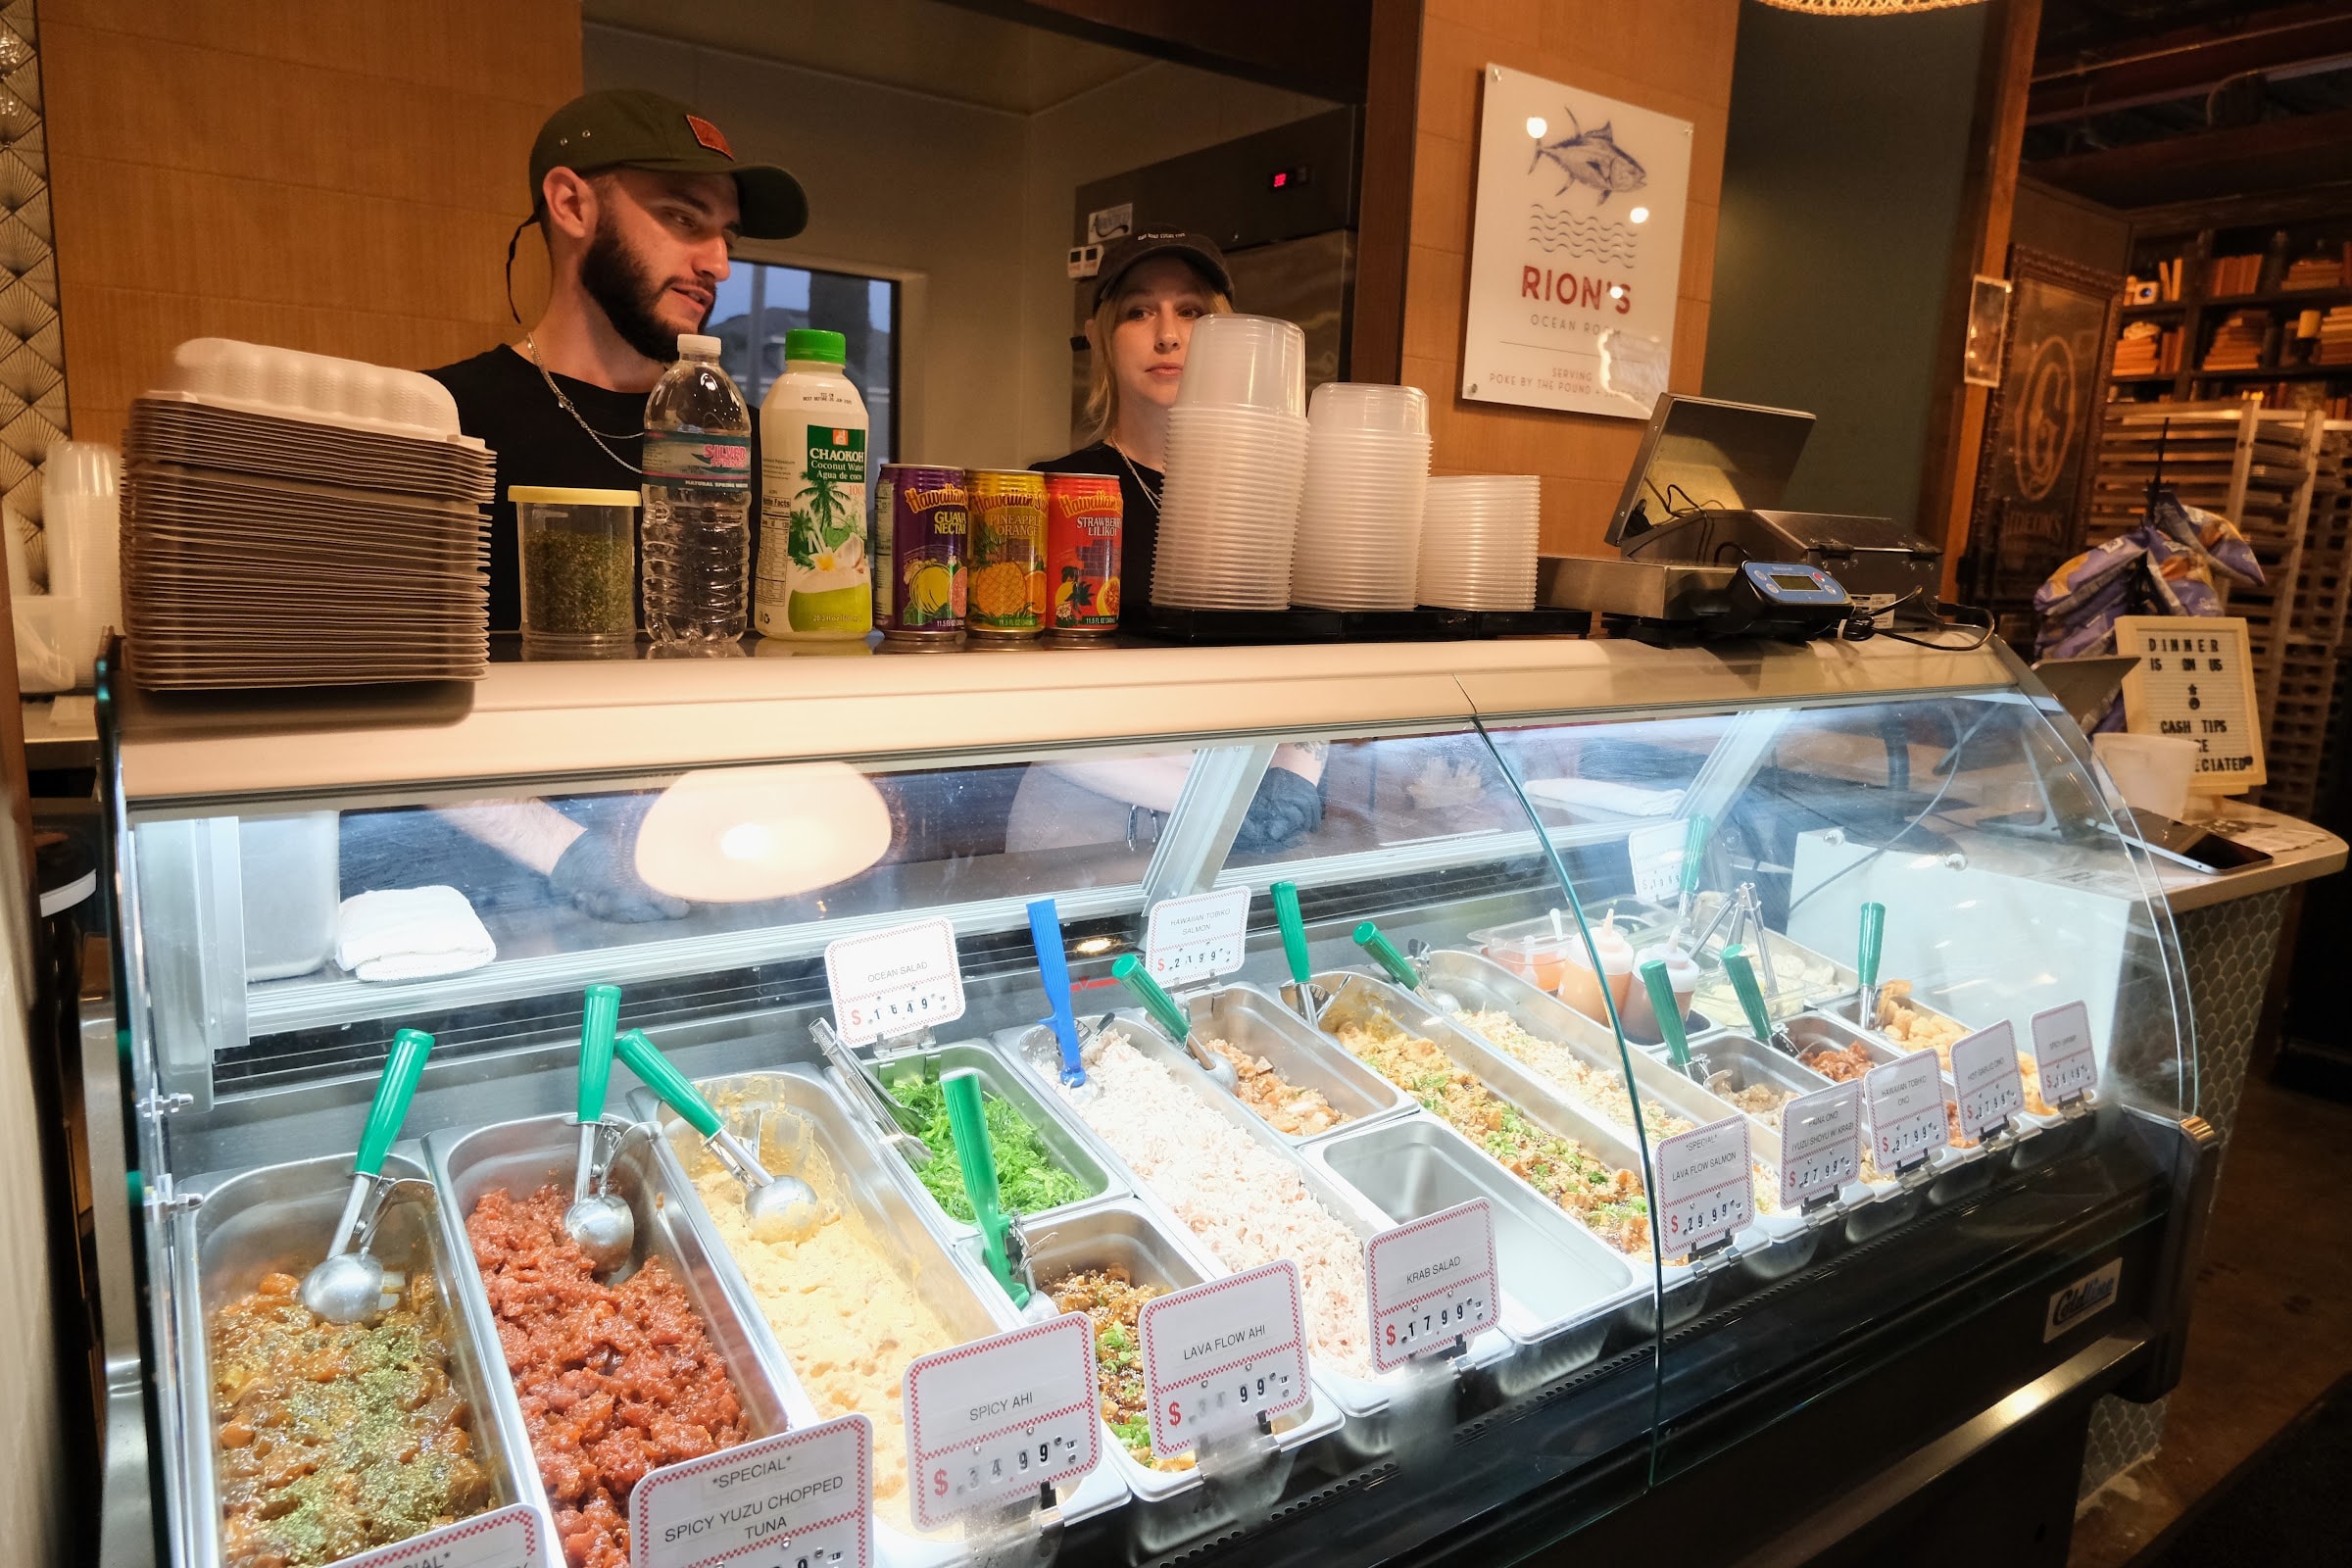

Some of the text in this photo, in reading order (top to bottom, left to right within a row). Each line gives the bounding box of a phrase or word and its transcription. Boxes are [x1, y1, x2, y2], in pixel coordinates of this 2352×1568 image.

[1521, 265, 1632, 315] RION'S
[1530, 314, 1576, 331] OCEAN
[1551, 368, 1592, 383] SERVING
[1489, 372, 1516, 386] POKE
[1520, 376, 1533, 388] BY
[1537, 378, 1554, 391] THE
[1558, 381, 1592, 395] POUND
[703, 443, 747, 461] SILVER
[808, 447, 864, 463] CHAOKOH
[810, 460, 846, 470] Coconut
[816, 469, 837, 480] Agua
[839, 470, 849, 480] de
[685, 479, 713, 488] NATURAL
[934, 511, 966, 524] GUAVA
[990, 514, 1043, 527] PINEAPPLE
[996, 525, 1038, 536] ORANGE
[2148, 638, 2219, 653] DINNER
[2150, 658, 2223, 672] IS ON US
[2160, 719, 2228, 734] CASH TIPS
[2195, 756, 2246, 772] CIATED
[1170, 907, 1231, 926] HAWAIIAN TOBIKO
[1182, 923, 1211, 936] SALMON
[867, 961, 928, 983] OCEAN SALAD
[1881, 1082, 1907, 1098] HAWAIIAN
[1897, 1096, 1910, 1106] ONO
[1825, 1110, 1838, 1122] ONO
[1809, 1133, 1830, 1146] SHOYU
[1672, 1152, 1738, 1182] LAVA FLOW SALMON
[1406, 1255, 1461, 1285] KRAB SALAD
[1183, 1324, 1266, 1361] LAVA FLOW AHI
[969, 1391, 1034, 1422] SPICY AHI
[664, 1475, 845, 1544] SPICY YUZU CHOPPED
[744, 1515, 789, 1541] TUNA
[831, 1551, 842, 1561] LB
